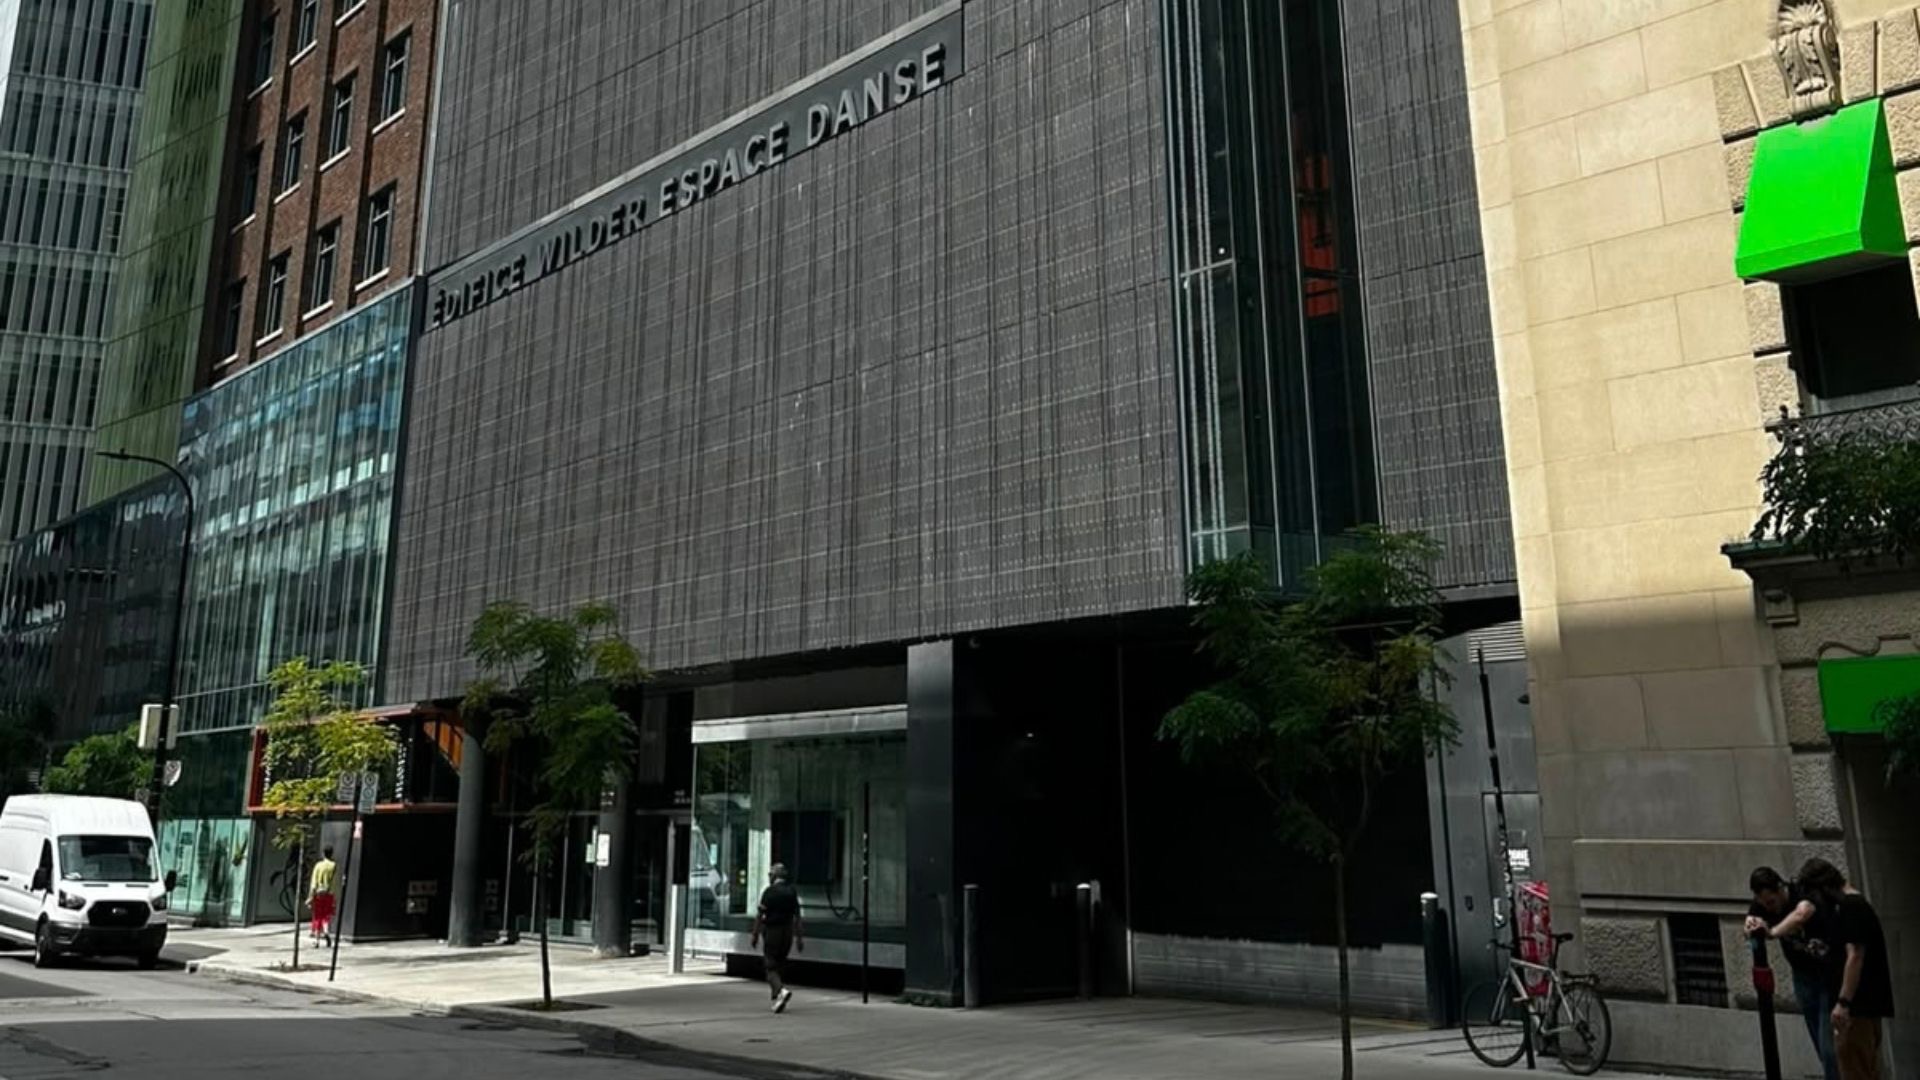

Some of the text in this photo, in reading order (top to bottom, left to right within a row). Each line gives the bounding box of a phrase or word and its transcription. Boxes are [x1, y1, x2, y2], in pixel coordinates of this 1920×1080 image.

[433, 43, 945, 327] ÉDIFICE WILDER ESPACE DANSE
